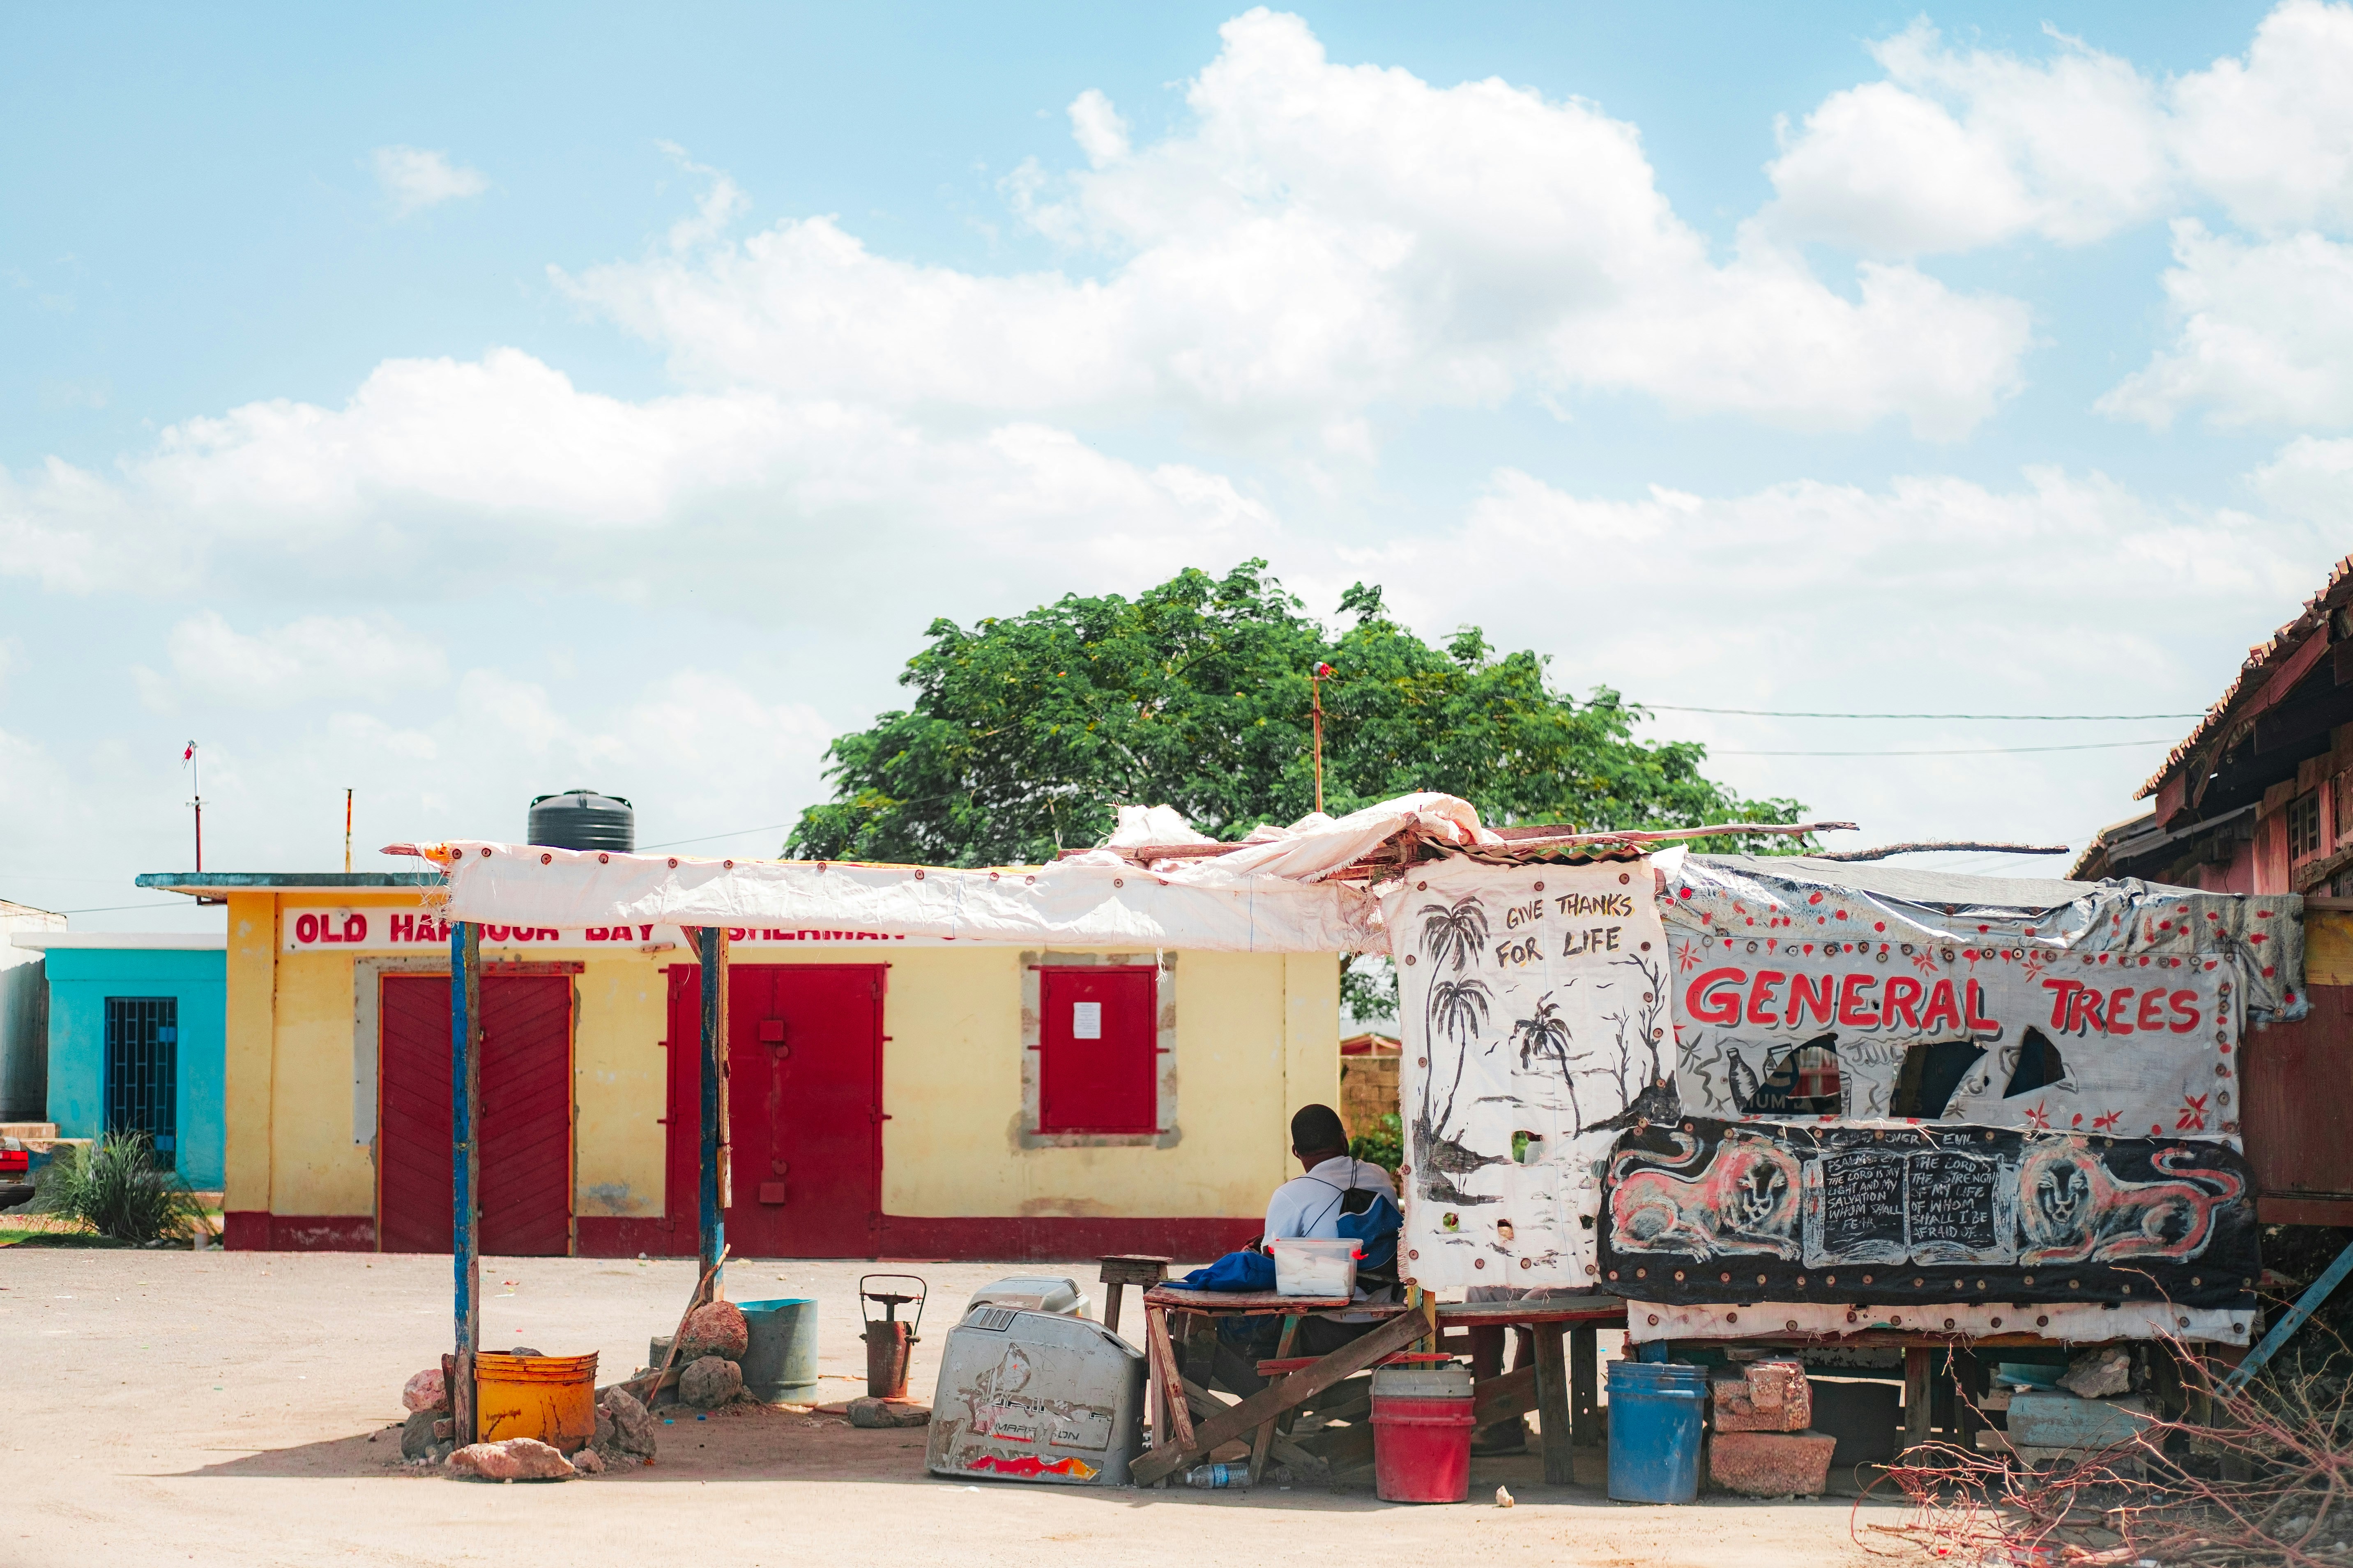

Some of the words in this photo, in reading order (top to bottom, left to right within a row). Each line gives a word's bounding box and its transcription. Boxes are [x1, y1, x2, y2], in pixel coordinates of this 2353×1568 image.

[1506, 899, 1544, 930] GIVE
[1555, 893, 1634, 917] THANKS
[296, 913, 367, 943] OLD
[1496, 937, 1544, 968] FOR
[1563, 927, 1622, 957] LIFE
[1685, 967, 2002, 1036] GENERAL
[2042, 979, 2201, 1035] TREES
[1885, 1133, 1921, 1146] OVER
[1943, 1133, 1976, 1146] EVIL
[1914, 1156, 1939, 1170] THE
[1945, 1157, 1976, 1172] LORD
[1826, 1176, 1844, 1185] THE
[1847, 1170, 1873, 1181] LORD
[1876, 1170, 1883, 1178] IS
[1886, 1167, 1900, 1178] MY
[1910, 1172, 1933, 1185] THE
[1941, 1171, 1996, 1184] STRENGTH
[1828, 1182, 1858, 1196] LIGHT
[1859, 1179, 1879, 1192] AND
[1881, 1178, 1897, 1194] MY
[1910, 1187, 1927, 1199] OF
[1932, 1184, 1950, 1198] MY
[1956, 1186, 1985, 1198] LIFE
[1827, 1191, 1886, 1209] SALVATION
[1911, 1200, 1926, 1214] OF
[1930, 1198, 1974, 1212] WHOM
[1829, 1204, 1865, 1219] WHOM
[1870, 1203, 1903, 1216] SHALL
[1911, 1212, 1955, 1225] SHALL
[1959, 1209, 1969, 1224] I
[1972, 1211, 1987, 1224] BE
[1826, 1220, 1838, 1230] I
[1912, 1225, 1957, 1239] AFRAID
